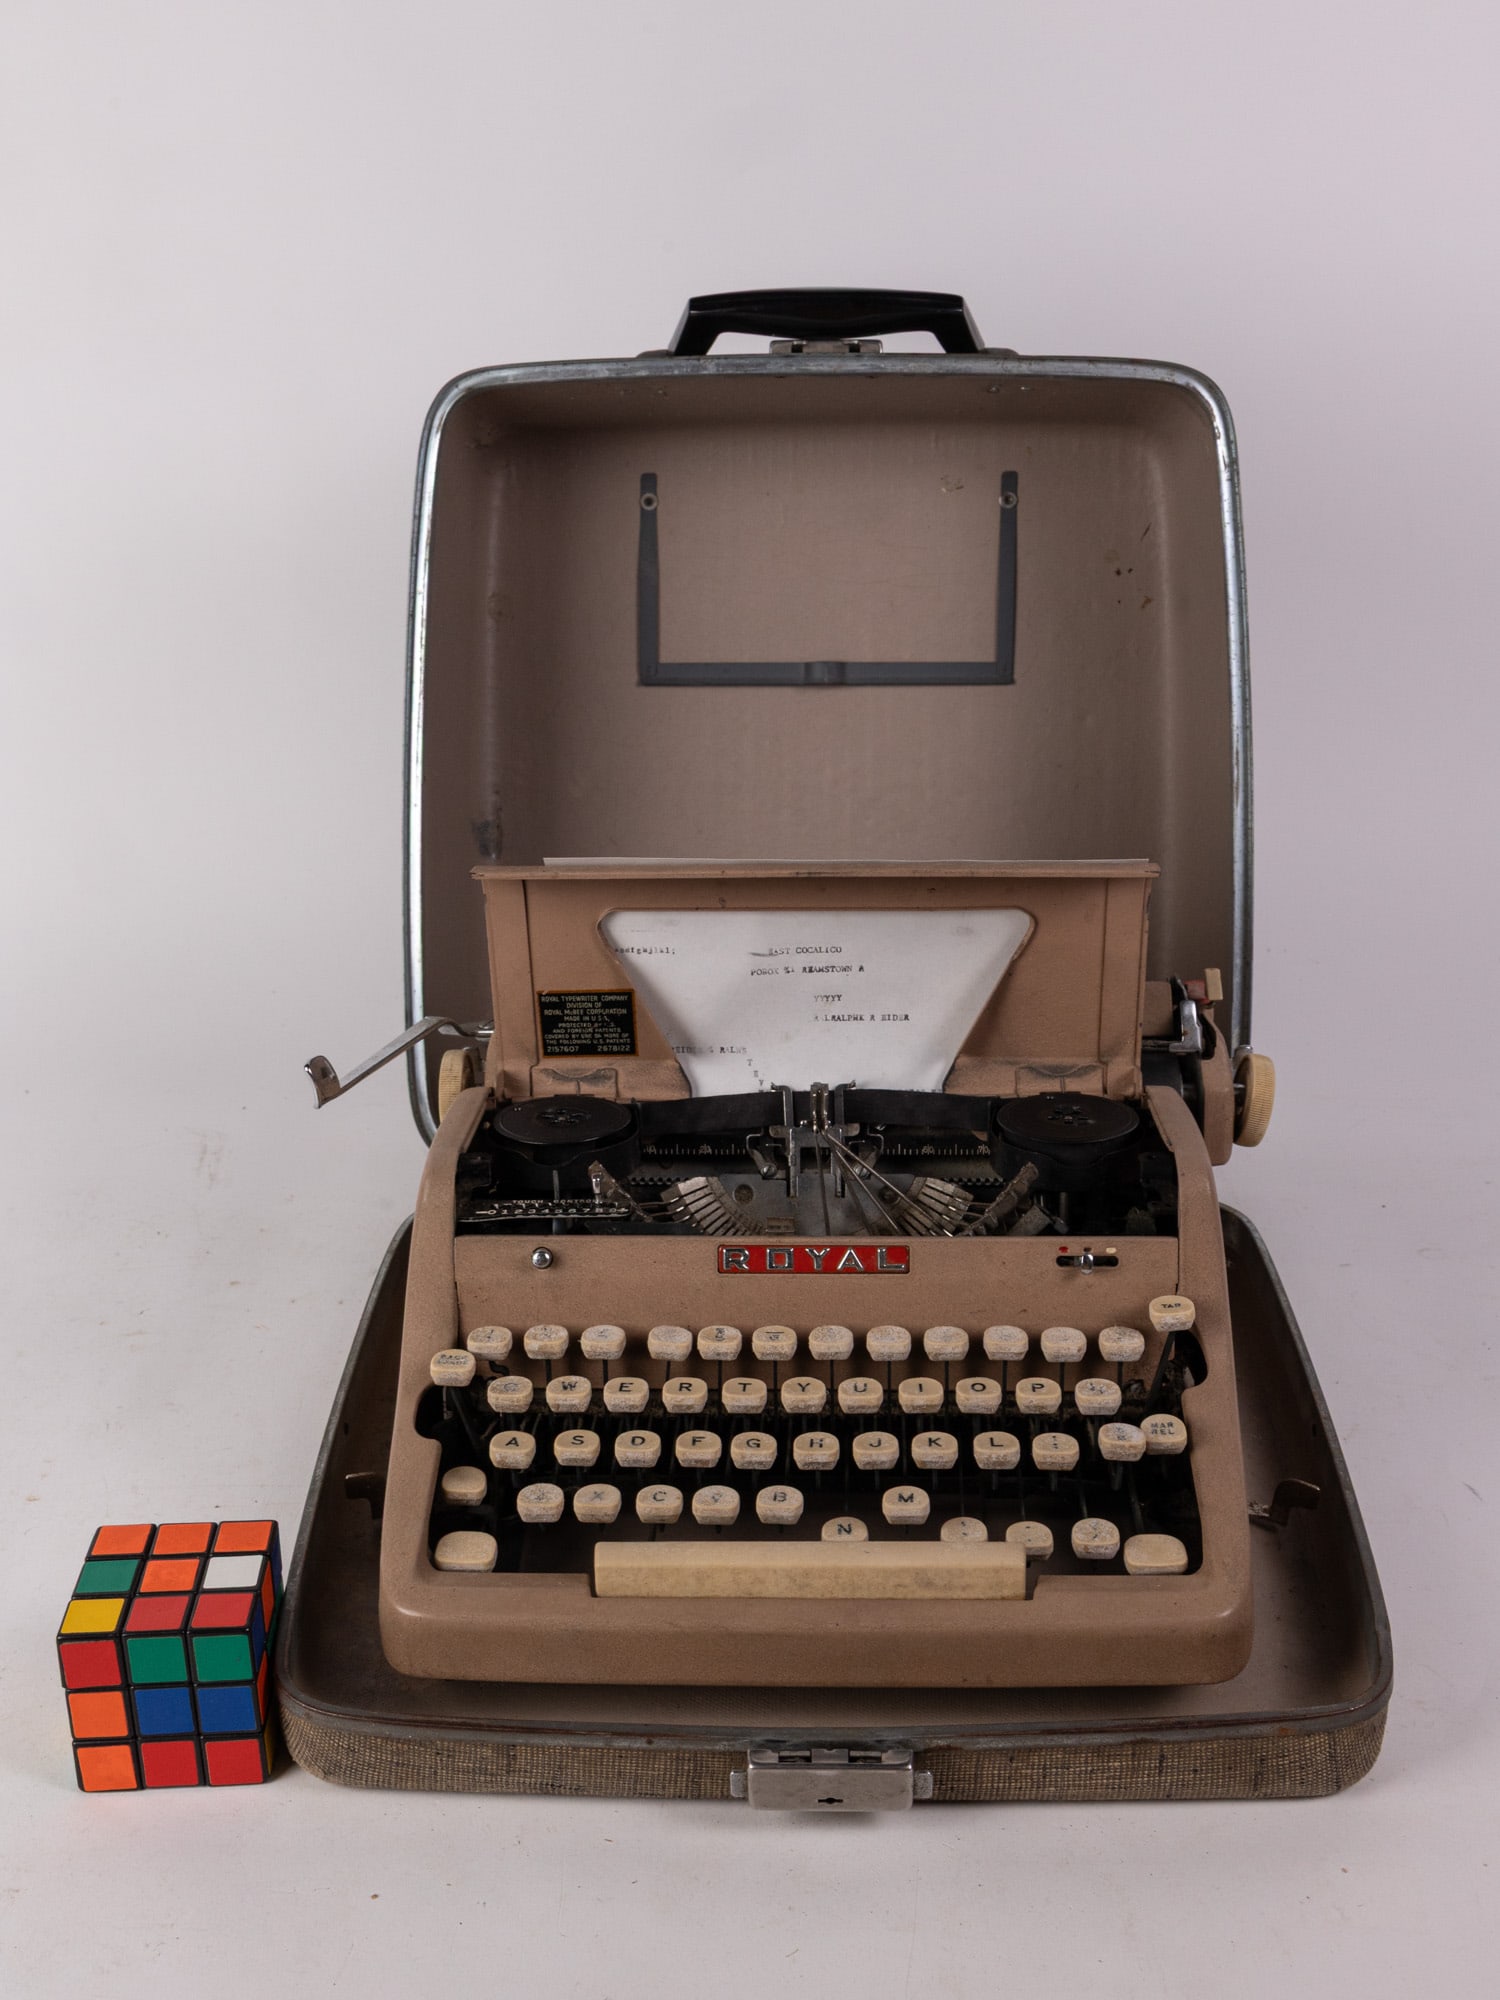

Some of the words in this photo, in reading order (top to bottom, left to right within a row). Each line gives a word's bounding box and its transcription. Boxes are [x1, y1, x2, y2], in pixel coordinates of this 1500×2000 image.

[796, 946, 842, 954] COCALICO
[547, 1045, 580, 1053] 2157607
[597, 1045, 631, 1053] 2678122
[722, 1247, 905, 1272] ROYAL
[561, 1381, 577, 1391] W
[618, 1382, 634, 1393] E
[679, 1382, 693, 1392] R
[738, 1382, 752, 1392] T
[797, 1382, 811, 1393] Y
[853, 1382, 868, 1393] U
[918, 1383, 924, 1393] I
[971, 1382, 986, 1392] O
[1031, 1383, 1045, 1392] P
[505, 1436, 520, 1447] A
[571, 1435, 585, 1445] S
[631, 1436, 646, 1446] D
[691, 1436, 706, 1446] F
[746, 1438, 761, 1448] G
[809, 1438, 824, 1448] H
[869, 1438, 882, 1447] J
[928, 1437, 942, 1447] K
[989, 1437, 1004, 1447] L
[653, 1491, 667, 1501] C
[773, 1491, 787, 1502] B
[898, 1493, 914, 1503] M
[837, 1523, 852, 1535] N
